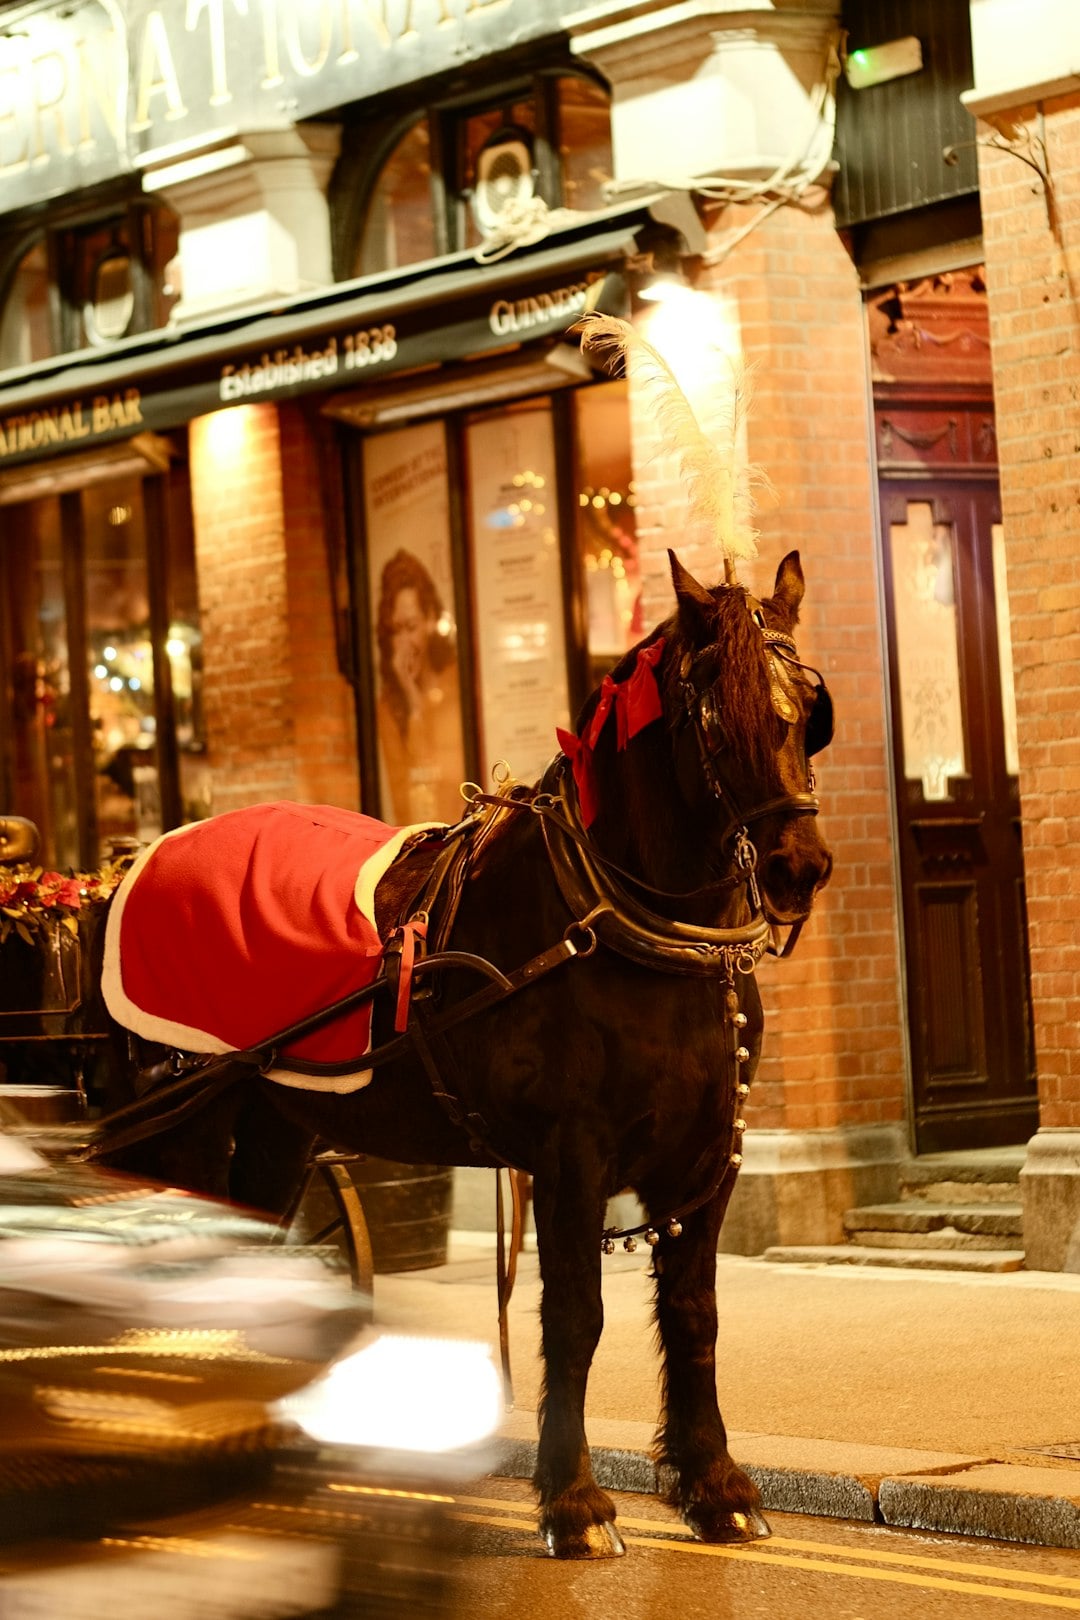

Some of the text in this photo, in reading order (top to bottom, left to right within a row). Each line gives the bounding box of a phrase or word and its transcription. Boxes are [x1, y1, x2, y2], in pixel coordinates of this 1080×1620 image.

[0, 0, 516, 177] ERNATIO
[489, 281, 587, 336] GUINNESS
[219, 323, 398, 401] Established 1838
[92, 388, 144, 434] BAR
